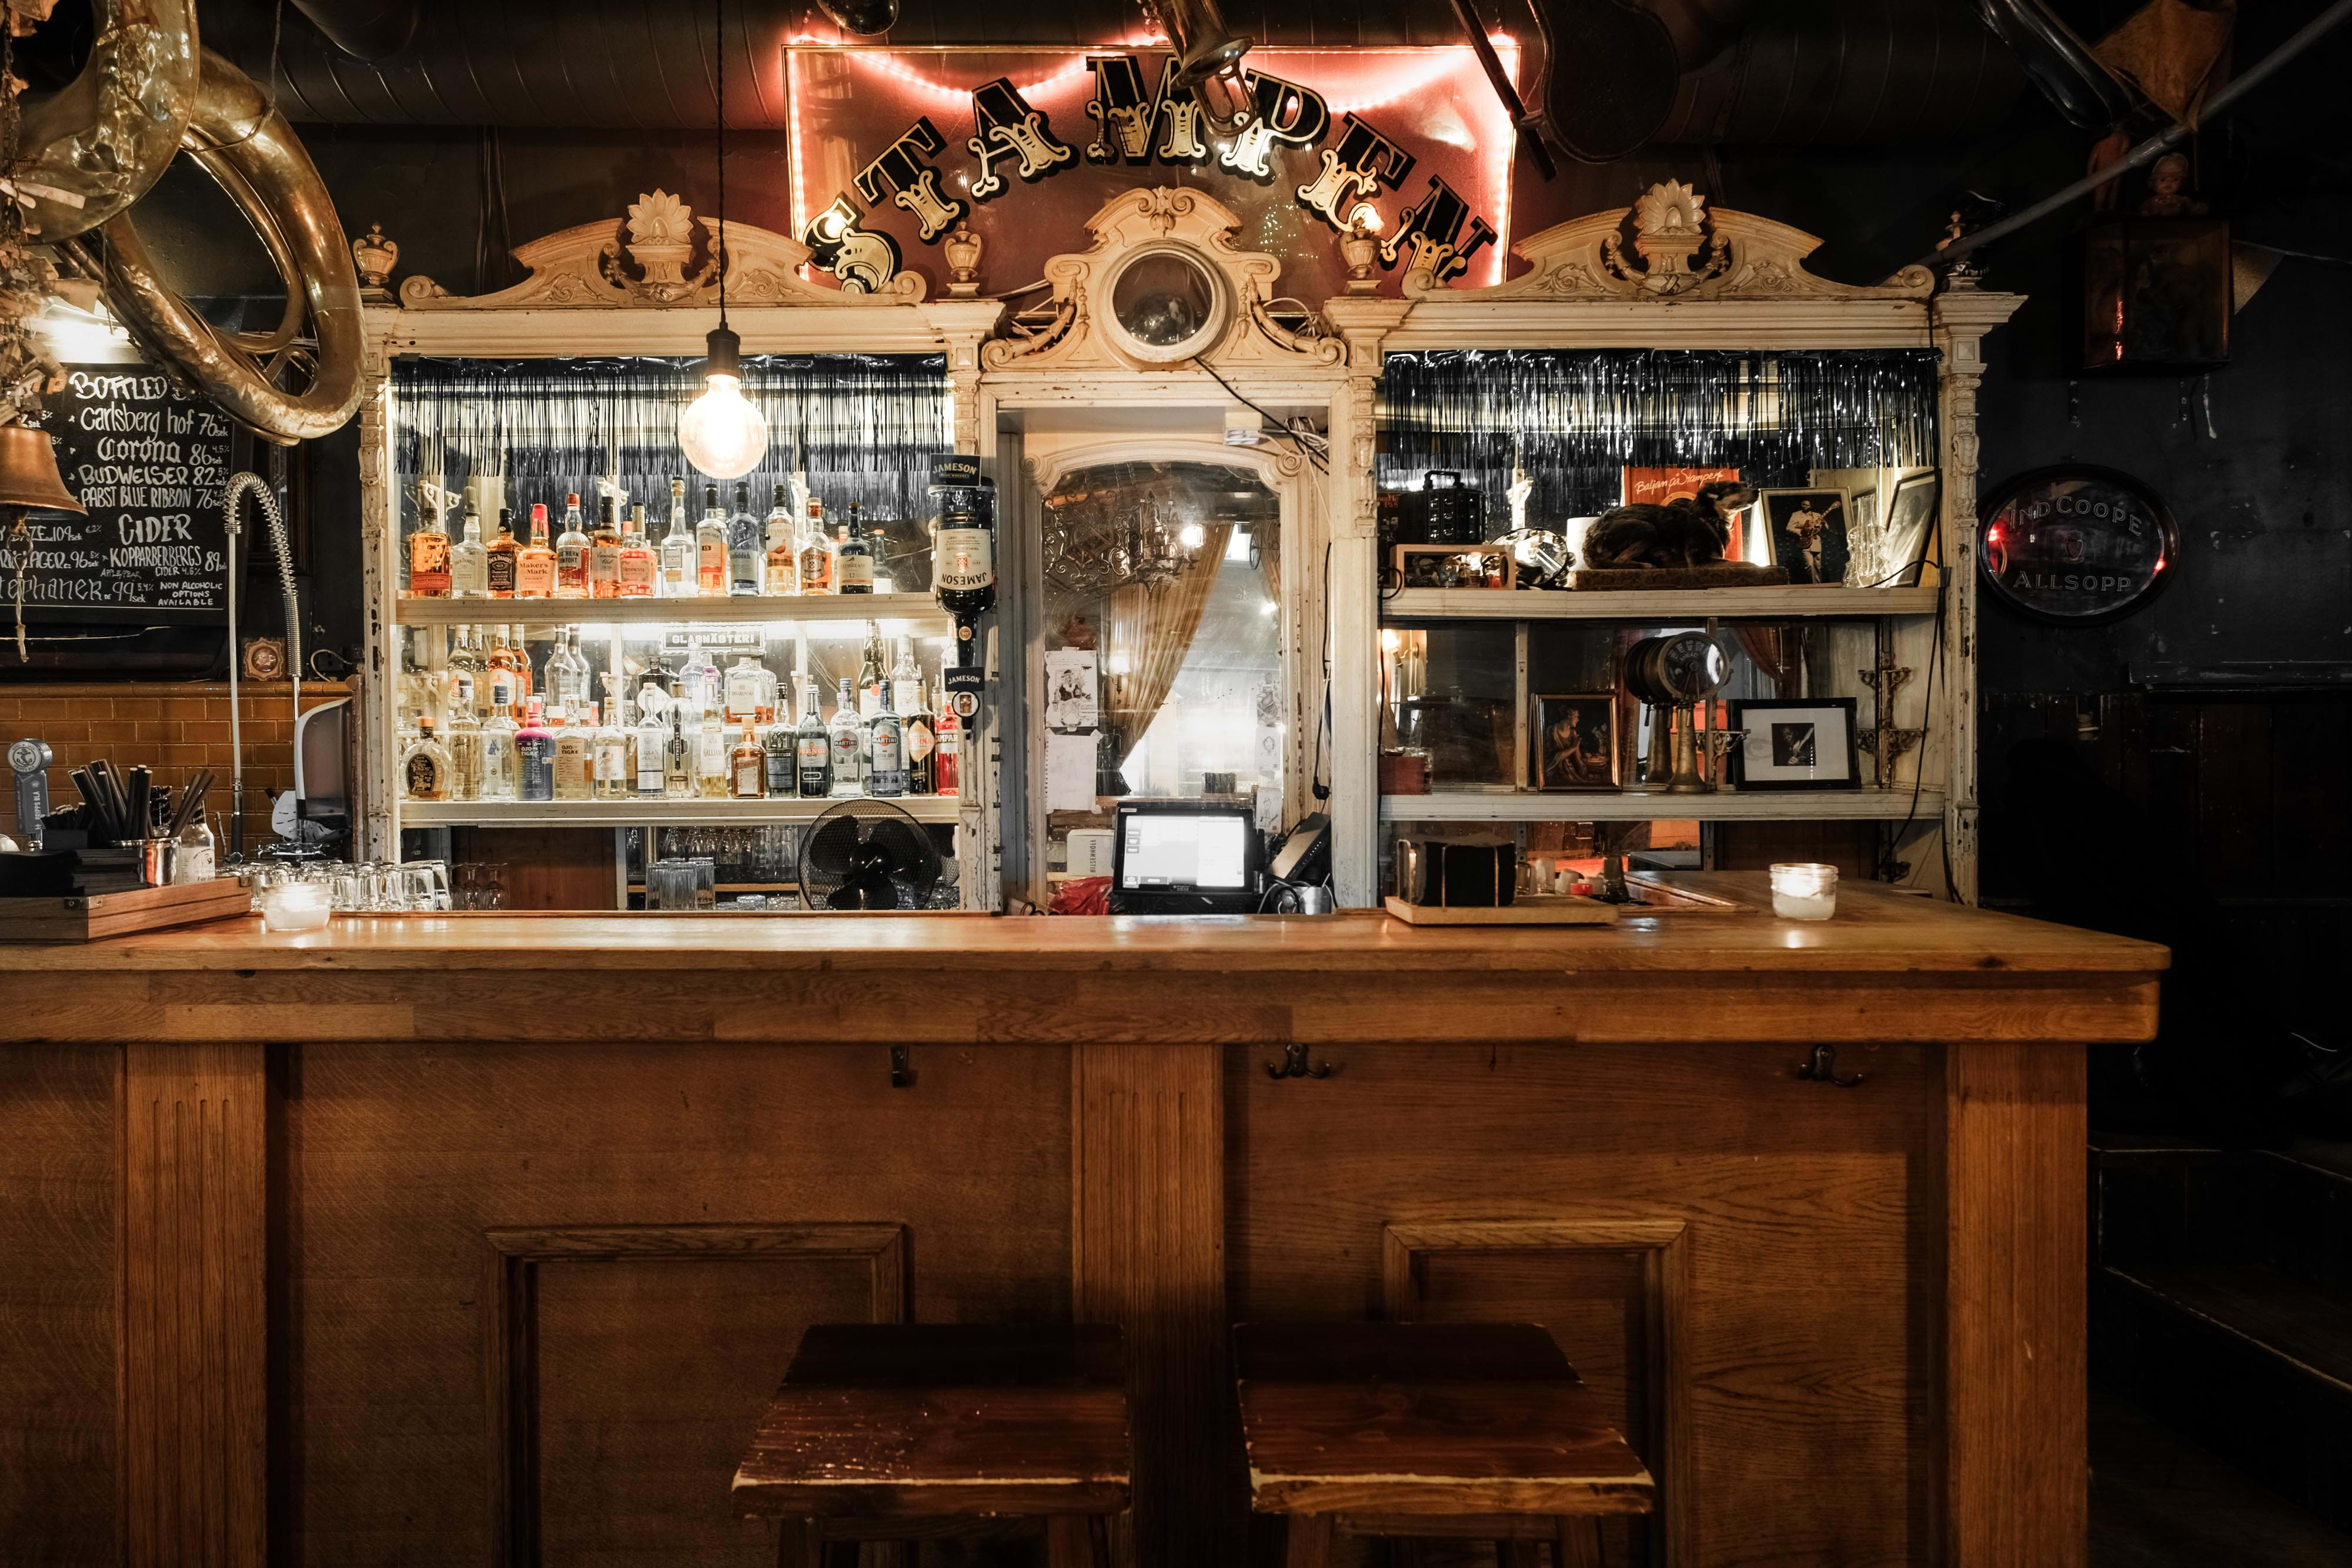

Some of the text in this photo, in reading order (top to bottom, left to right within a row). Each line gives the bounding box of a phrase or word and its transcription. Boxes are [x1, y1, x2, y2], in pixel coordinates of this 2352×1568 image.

[802, 55, 1498, 295] STAMPEN
[69, 372, 168, 400] BOTTLED
[80, 400, 229, 441] Carlsberg hof 76 sek
[97, 436, 182, 464] Corona
[189, 443, 212, 466] 86
[212, 444, 230, 453] 4.5%
[78, 464, 189, 486] BUDWEISER
[192, 466, 215, 486] 82
[218, 467, 229, 476] 5%
[932, 462, 977, 475] JAMESON
[81, 486, 118, 508] PABST
[119, 486, 148, 507] BLUE
[151, 486, 192, 509] RIBBON
[195, 489, 213, 509] 76
[1635, 480, 1668, 496] Baljan
[2009, 495, 2143, 537] IND COOPE
[52, 526, 72, 541] 109
[118, 513, 193, 546] CIDER
[70, 551, 88, 569] 96
[204, 551, 220, 573] 89
[155, 566, 181, 577] CIDER
[941, 571, 987, 586] JAMESON
[2012, 570, 2132, 593] ALLSOPP
[112, 581, 134, 602] 99
[132, 593, 146, 603] sek
[159, 580, 223, 590] NON ALCOHOLIC
[172, 590, 211, 599] OPTIONS
[157, 597, 214, 607] AVAILABLE
[947, 675, 981, 685] JAMESON
